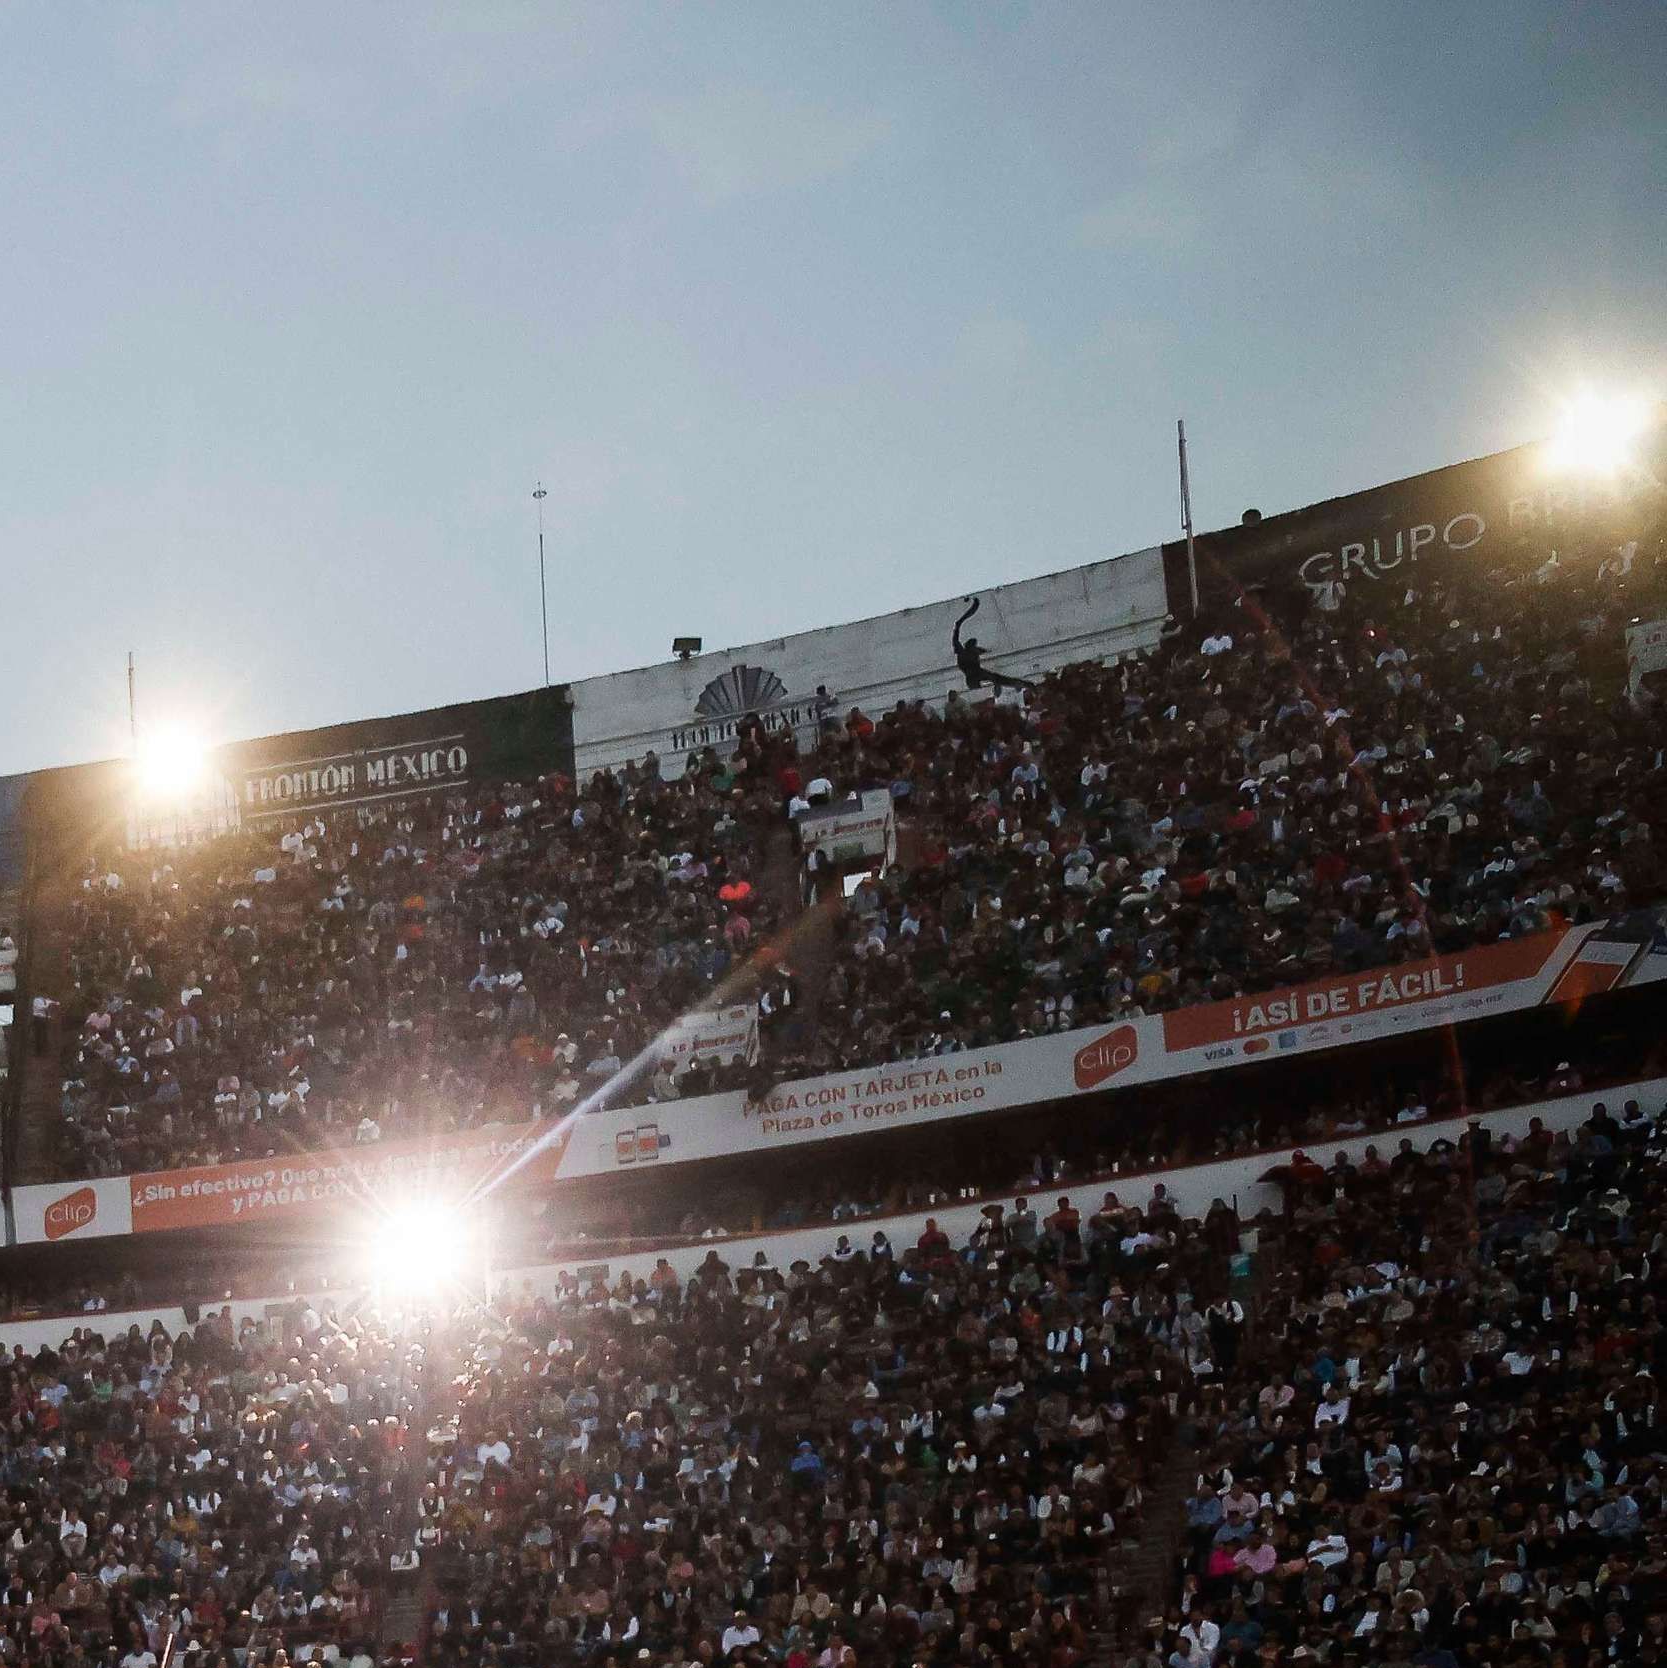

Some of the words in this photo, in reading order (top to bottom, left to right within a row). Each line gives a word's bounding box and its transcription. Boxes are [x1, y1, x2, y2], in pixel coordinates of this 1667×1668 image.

[1298, 512, 1486, 588] GRUPO
[1233, 996, 1299, 1033] ¡ASÍ
[1306, 990, 1351, 1019] DE
[1357, 962, 1465, 1003] FÁCIL!
[1078, 1044, 1132, 1072] clip
[804, 1086, 847, 1108] CON
[852, 1067, 948, 1099] TARJETA
[954, 1066, 980, 1082] en
[984, 1060, 1003, 1076] la
[762, 1115, 815, 1134] Plaza
[819, 1108, 844, 1127] de
[851, 1100, 908, 1120] Toros
[49, 1202, 92, 1225] clip
